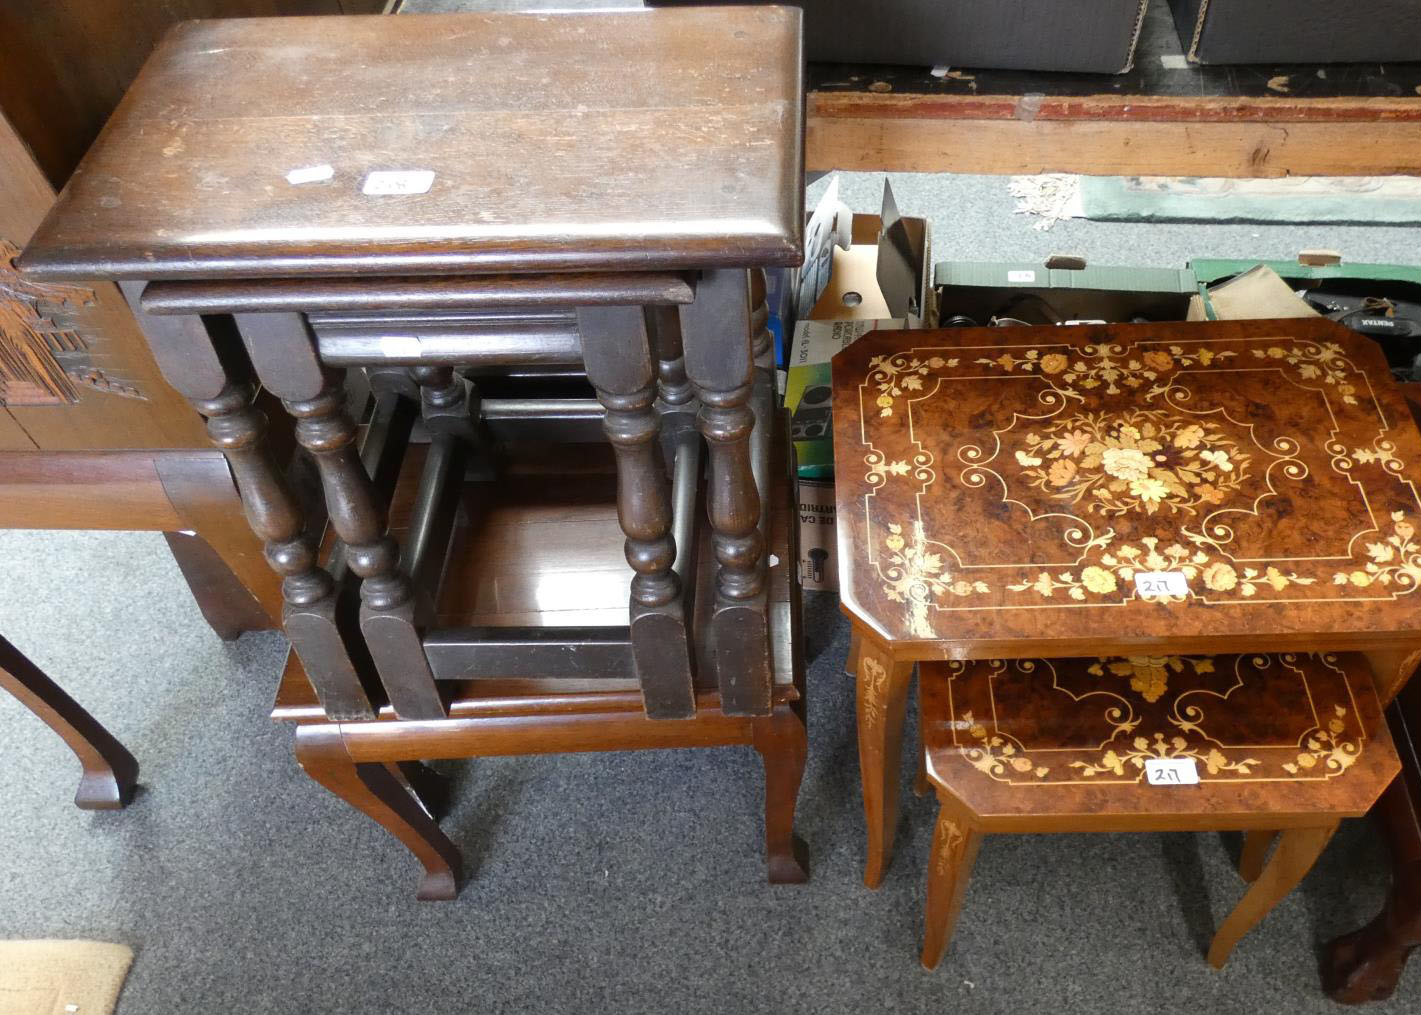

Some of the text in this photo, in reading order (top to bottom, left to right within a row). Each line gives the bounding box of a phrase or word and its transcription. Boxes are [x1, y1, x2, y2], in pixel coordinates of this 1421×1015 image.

[1361, 319, 1395, 327] PENTAX
[1142, 580, 1170, 592] 217
[1155, 768, 1180, 783] 217
